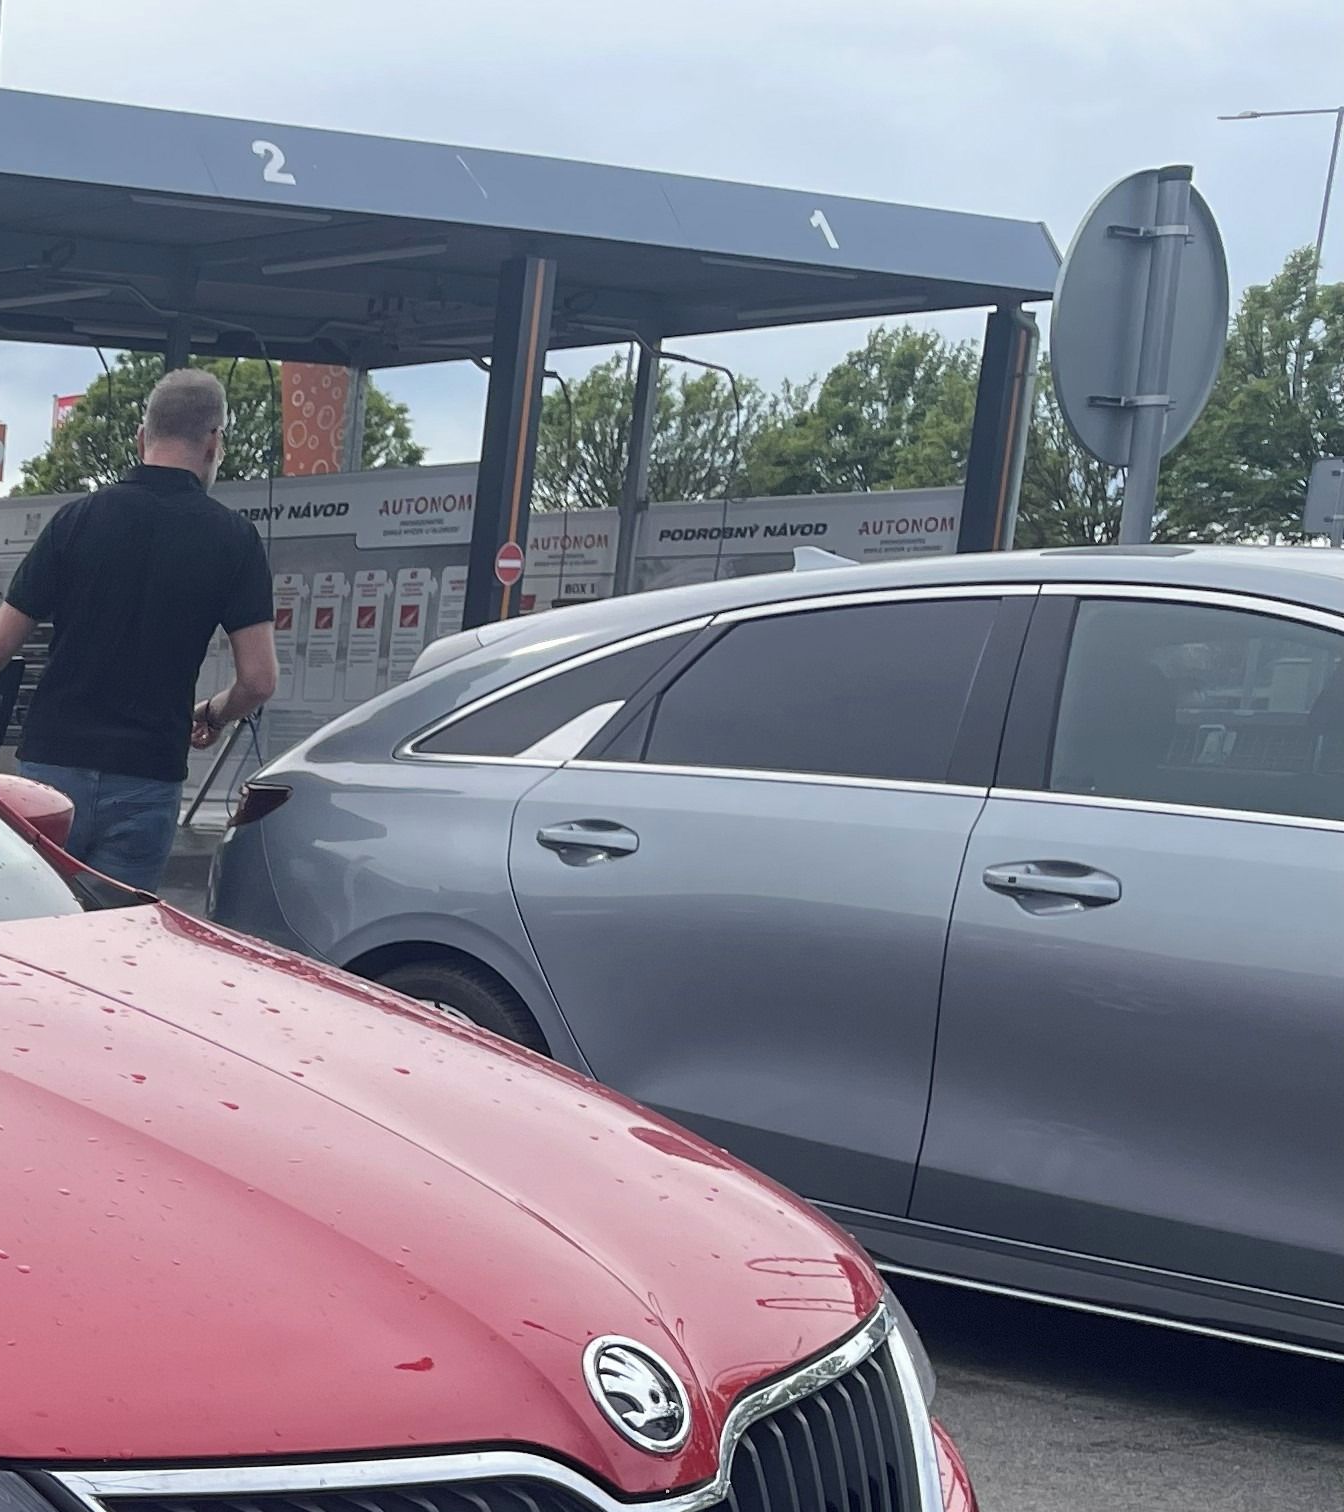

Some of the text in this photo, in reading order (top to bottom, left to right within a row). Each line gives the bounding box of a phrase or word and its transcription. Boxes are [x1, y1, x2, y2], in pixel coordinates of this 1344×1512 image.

[252, 140, 297, 186] 2
[809, 209, 840, 249] 1
[288, 501, 350, 520] NÁVOD
[378, 494, 472, 516] AUTONOM
[658, 521, 828, 543] PODROBNÝ NÁVOD
[858, 516, 955, 536] AUTONOM
[529, 533, 609, 551] AUTONOM
